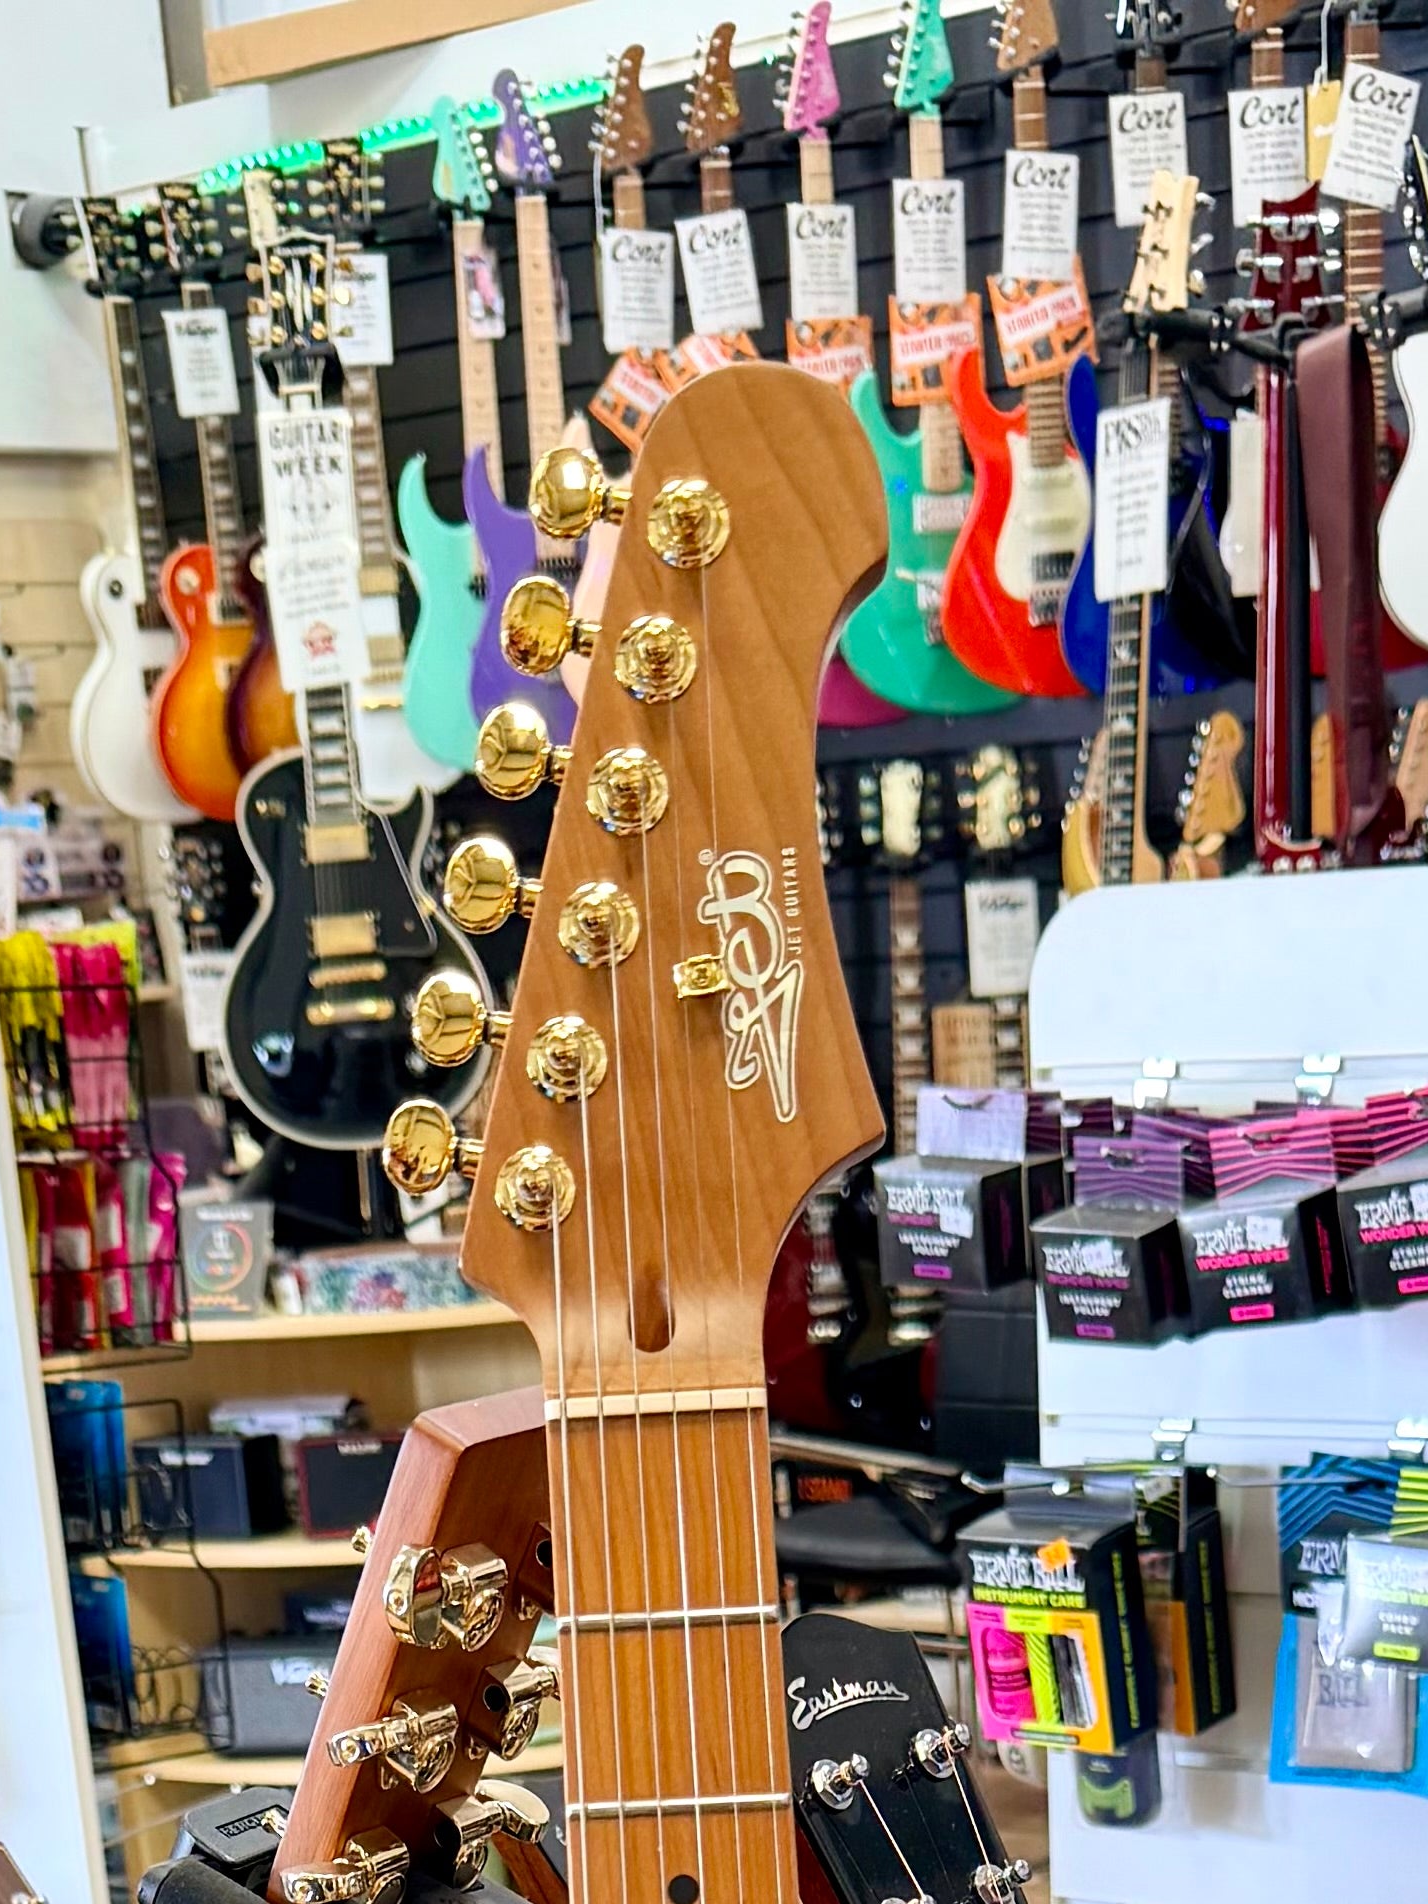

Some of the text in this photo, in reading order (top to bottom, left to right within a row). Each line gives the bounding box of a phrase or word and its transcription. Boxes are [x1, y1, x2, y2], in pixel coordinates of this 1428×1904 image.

[1350, 72, 1412, 114] Cort
[1119, 102, 1176, 133] Cort
[1240, 94, 1299, 129] Cort
[1014, 158, 1070, 190] Cort
[901, 186, 956, 215] Cort
[689, 221, 742, 254] Cort
[796, 210, 847, 240] Cort
[612, 235, 666, 264] Cort
[274, 455, 342, 477] WEEK
[780, 847, 803, 955] JET GUITARS
[1354, 1187, 1411, 1229] ERNIE
[1193, 1220, 1245, 1256] ERNIE
[1359, 1225, 1417, 1245] WONDER
[1196, 1253, 1250, 1272] WONDER
[968, 1544, 1030, 1589] ERNIE
[972, 1586, 1086, 1609] INSTRUMENT CARE
[787, 1675, 910, 1731] Eastman
